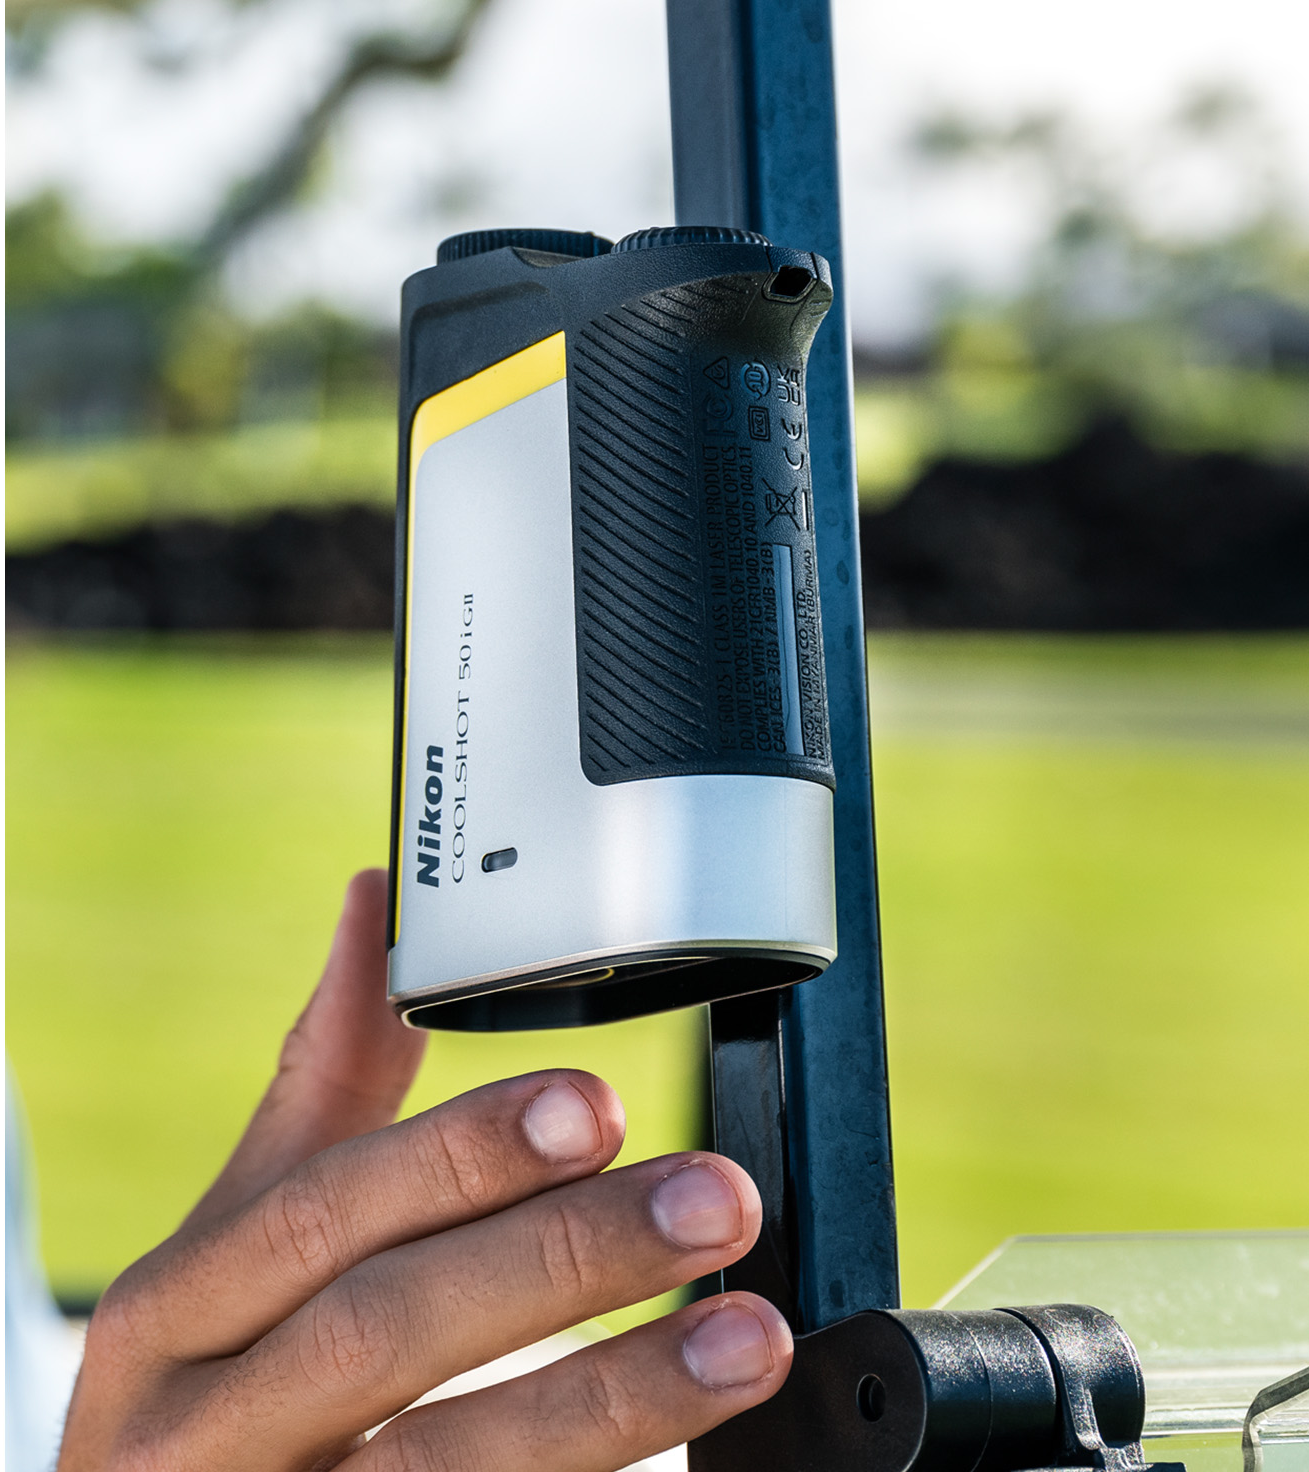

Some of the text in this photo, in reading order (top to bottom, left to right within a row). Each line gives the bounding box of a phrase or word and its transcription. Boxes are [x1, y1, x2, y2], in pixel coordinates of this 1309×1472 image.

[782, 416, 805, 471] CE
[703, 441, 723, 514] PRODUCT
[740, 445, 754, 496] 1040.11
[725, 492, 745, 571] TELESCOPIC
[743, 500, 757, 534] AND
[708, 519, 727, 568] LASER
[712, 574, 728, 596] 1M
[731, 576, 747, 594] OF
[713, 604, 733, 651] CLASS
[732, 597, 749, 638] USERS
[734, 640, 752, 693] EXPOSE
[752, 638, 767, 677] WITH
[801, 653, 814, 702] VISION
[805, 548, 826, 759] MADE IN MYANMAR (BURMA)
[737, 695, 754, 725] NOT
[754, 678, 772, 751] COMPLIES
[804, 705, 818, 758] NIKON
[740, 728, 756, 750] DO
[773, 721, 788, 753] CAN
[451, 690, 470, 884] COOLSHOT
[417, 745, 443, 888] Nikon
